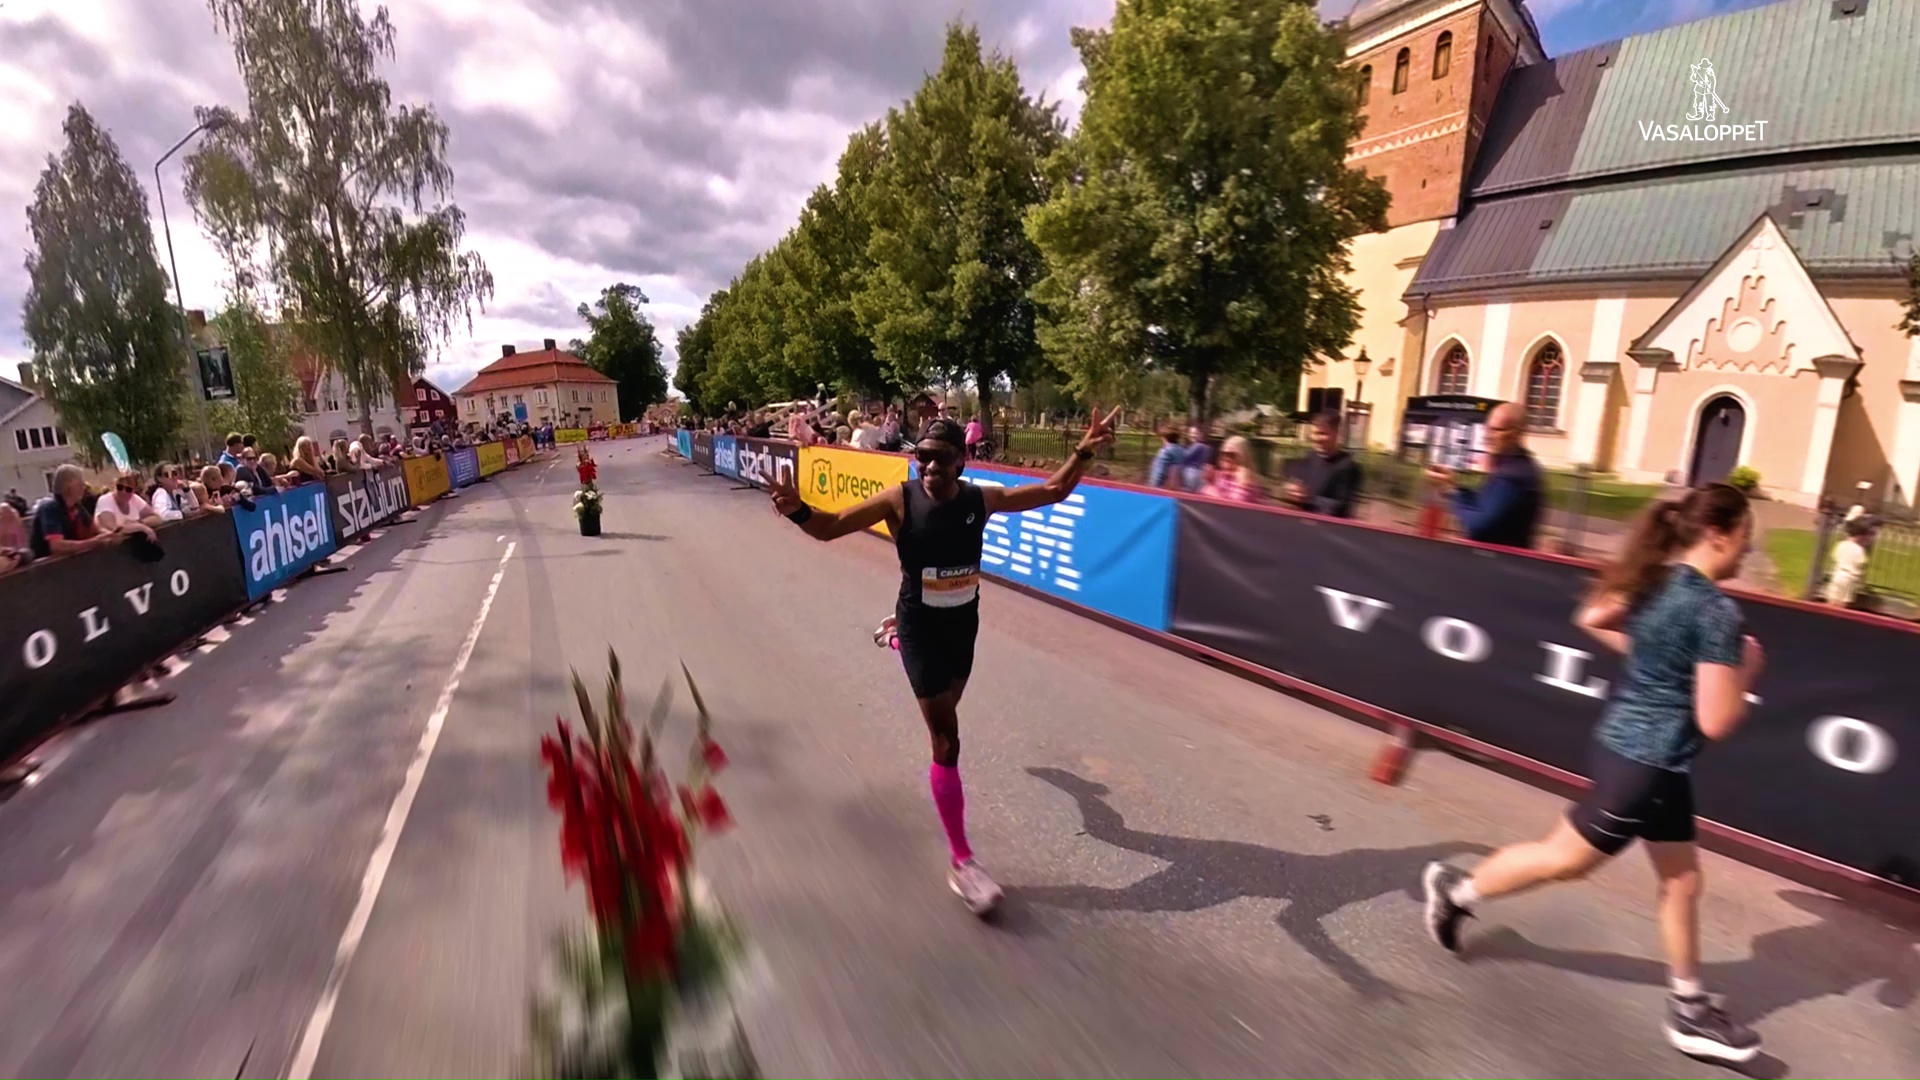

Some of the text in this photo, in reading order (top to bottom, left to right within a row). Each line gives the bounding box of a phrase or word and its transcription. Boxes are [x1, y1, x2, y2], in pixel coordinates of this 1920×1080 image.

[836, 472, 885, 499] preem
[250, 492, 329, 582] ahlsell
[940, 567, 970, 577] CRAFT
[957, 476, 1086, 592] BM
[1313, 584, 1898, 775] VOLO
